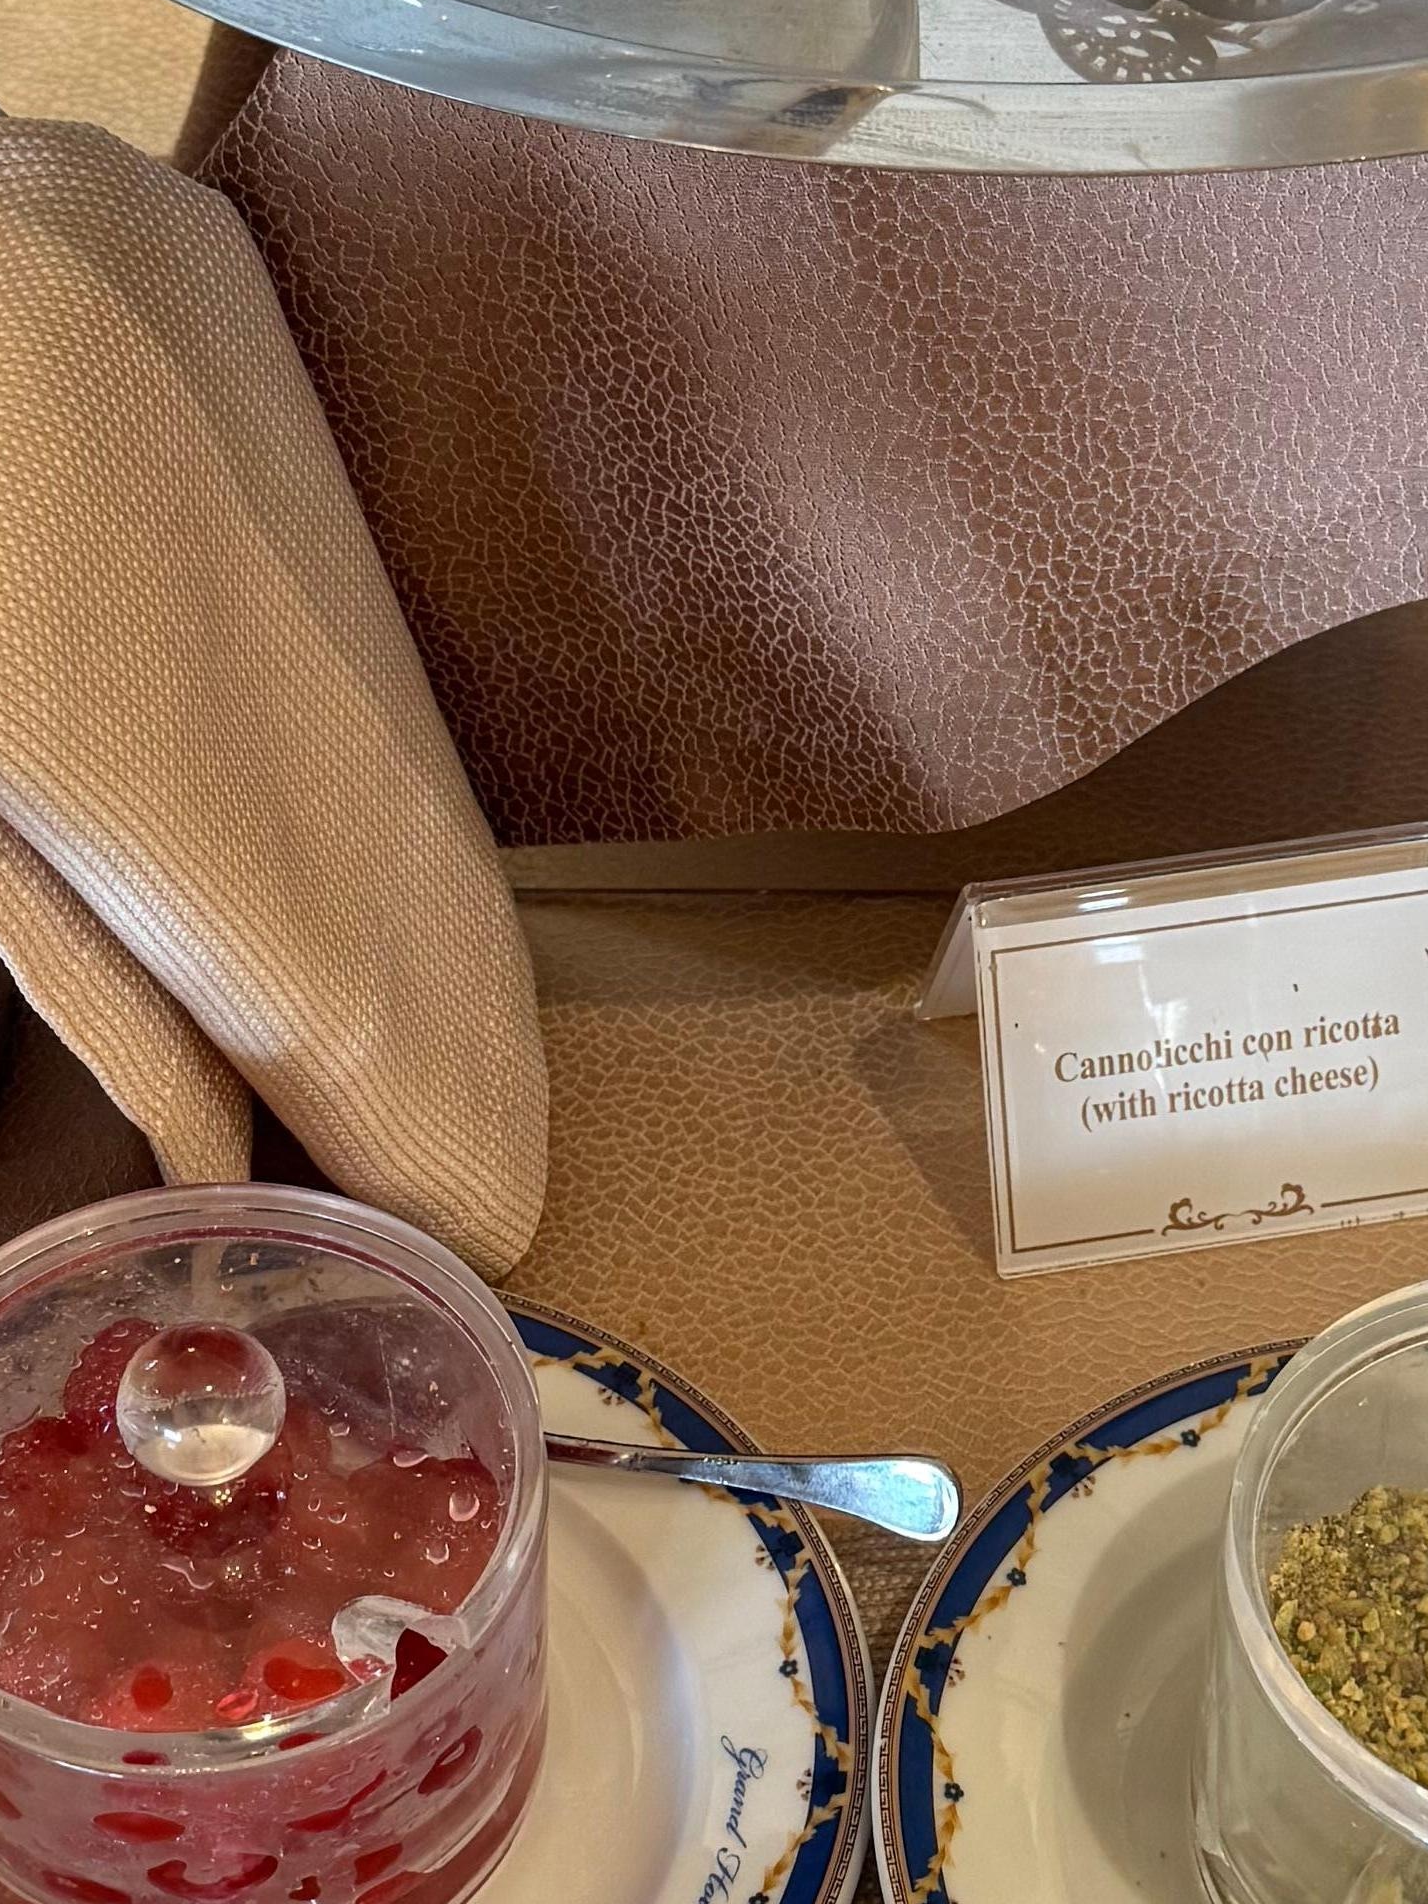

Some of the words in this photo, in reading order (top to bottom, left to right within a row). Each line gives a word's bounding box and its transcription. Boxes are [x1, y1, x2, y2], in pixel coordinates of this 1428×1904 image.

[1054, 1030, 1232, 1083] Cannolicchi
[1242, 1028, 1292, 1057] con
[1303, 1011, 1401, 1048] ricotta
[1081, 1088, 1158, 1132] (with
[1167, 1075, 1266, 1114] ricotta
[1274, 1055, 1380, 1099] cheese)
[720, 1734, 769, 1849] Grand
